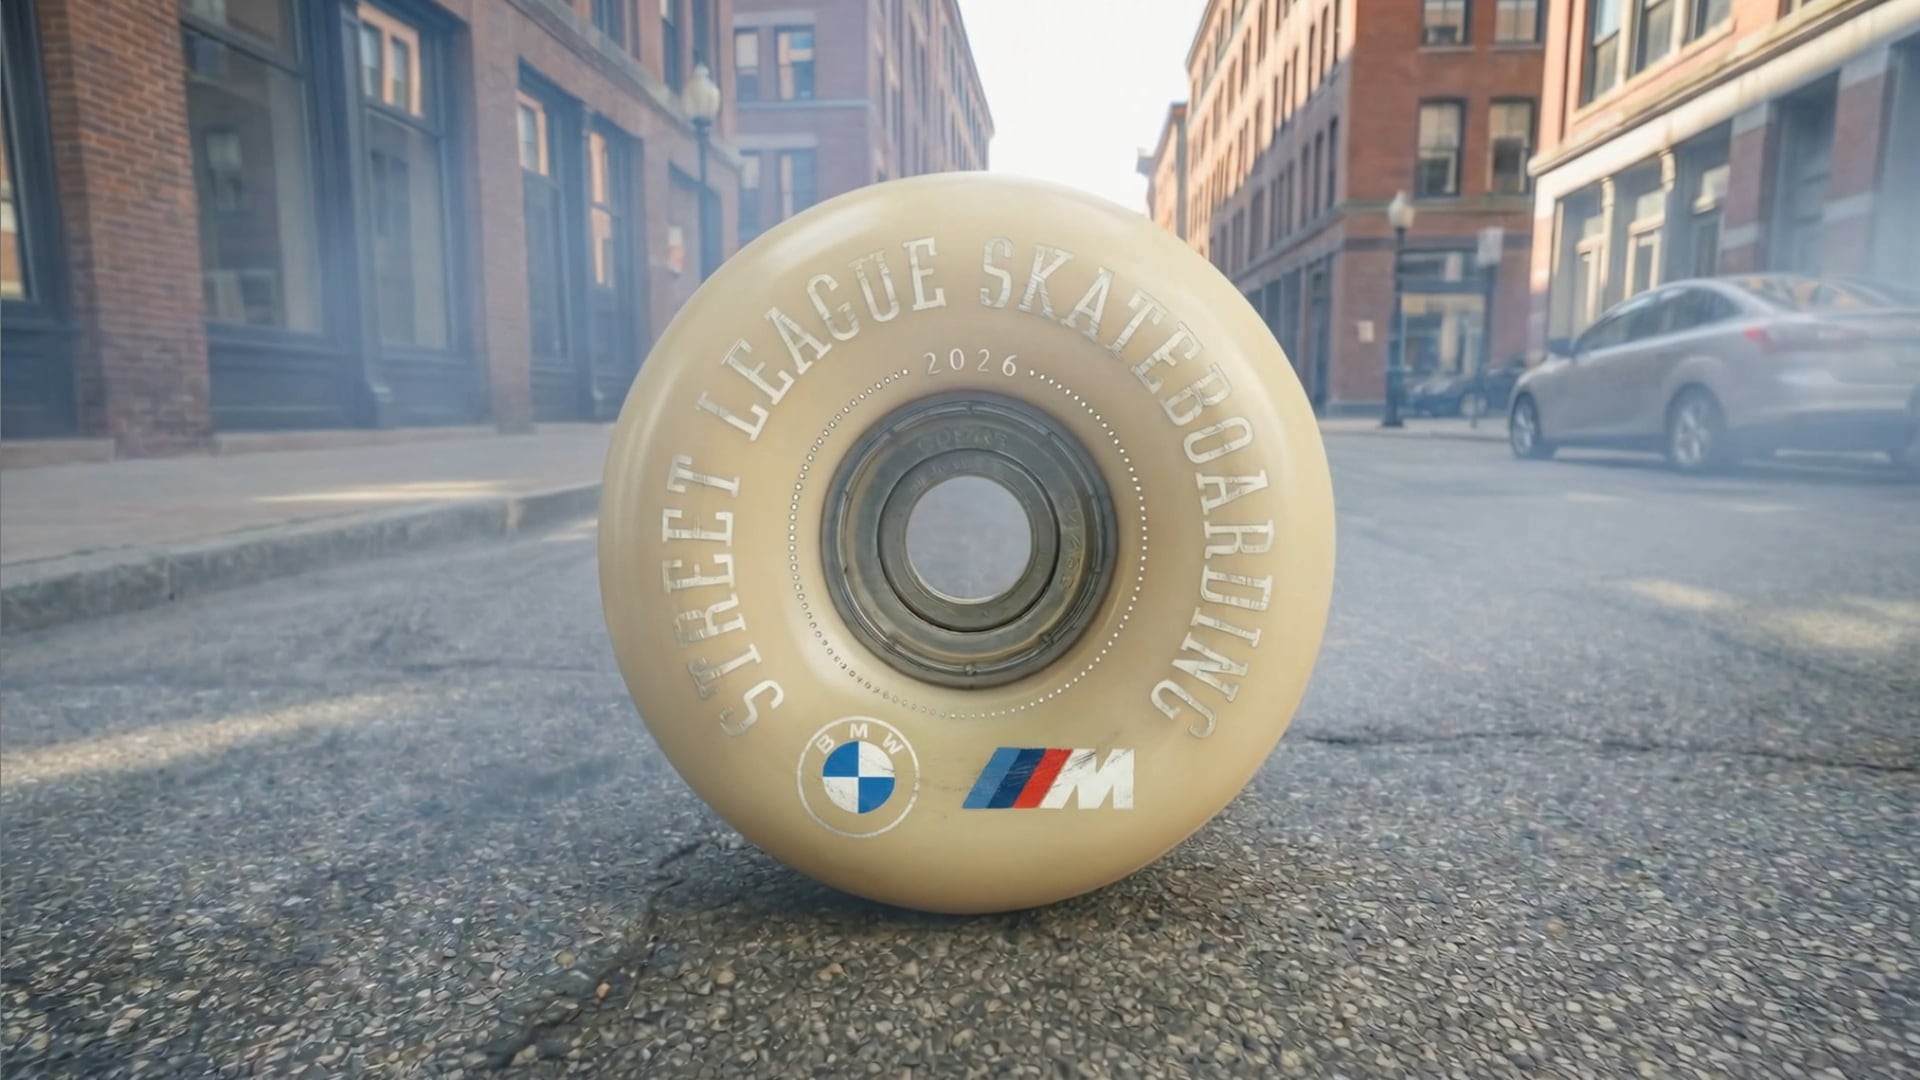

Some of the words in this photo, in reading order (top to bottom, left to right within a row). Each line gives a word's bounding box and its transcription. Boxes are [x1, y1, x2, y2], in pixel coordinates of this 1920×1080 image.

[696, 237, 947, 441] LEAGUE
[922, 347, 1017, 377] 2026
[979, 236, 1275, 739] SKATEBOARDING
[663, 454, 785, 737] STREET
[816, 722, 904, 755] BMW
